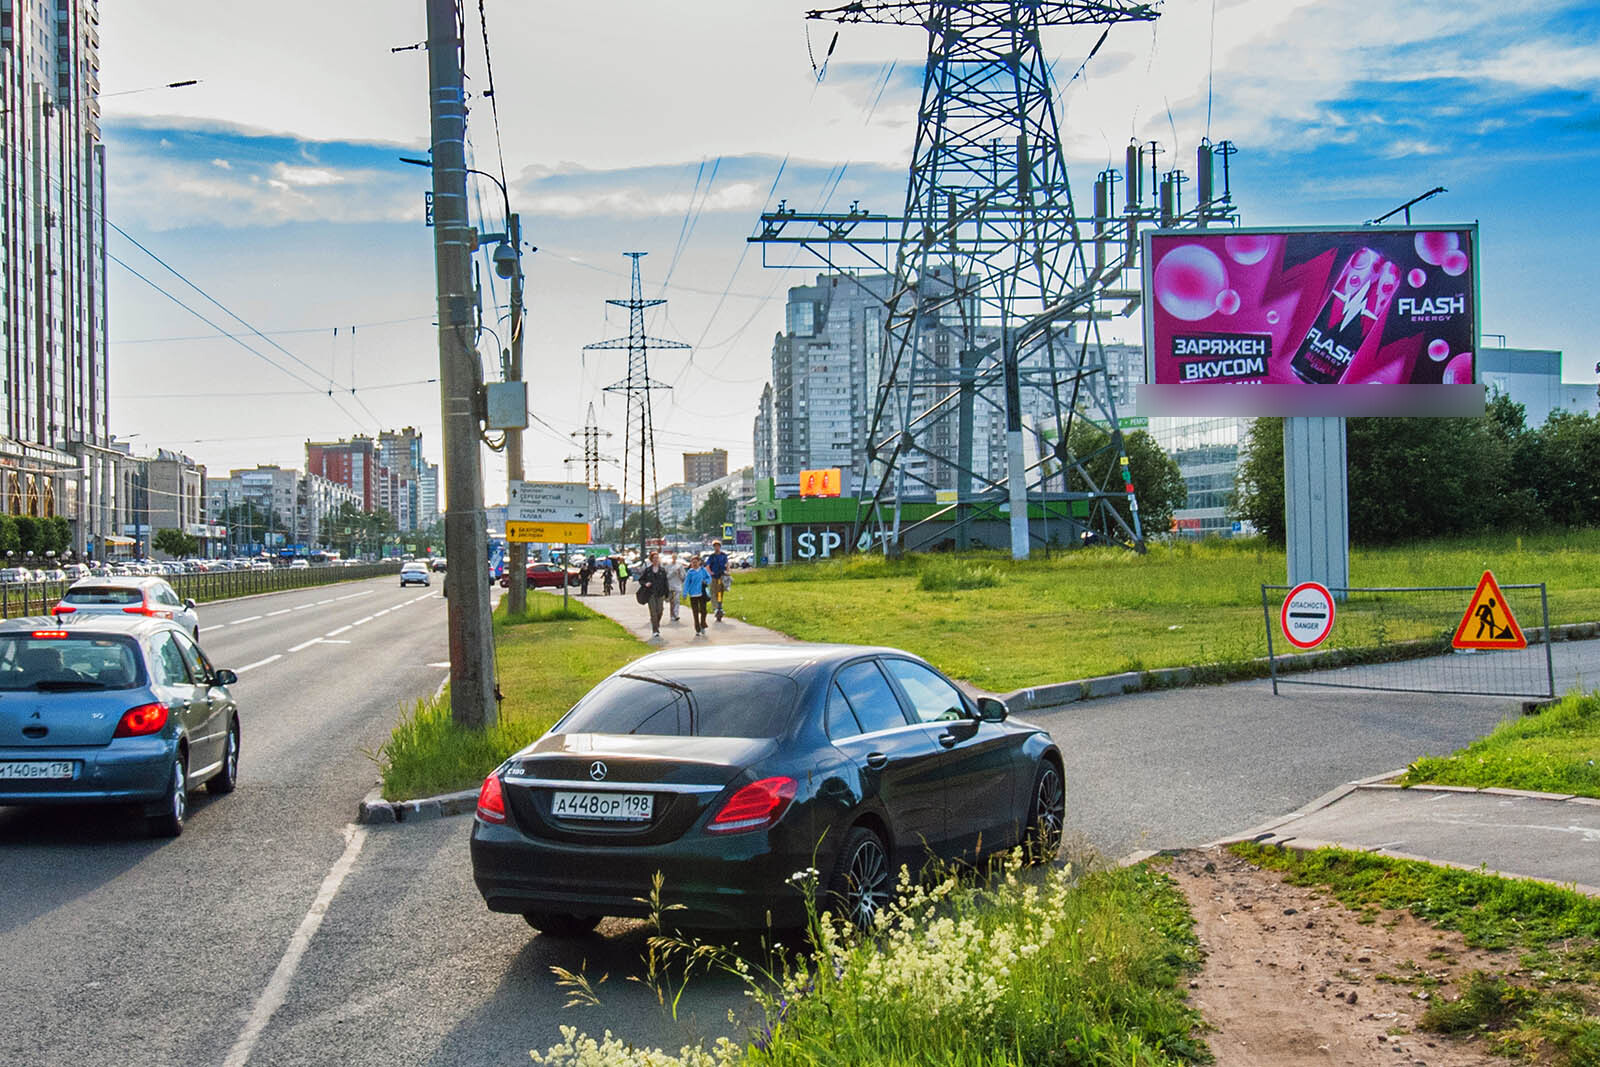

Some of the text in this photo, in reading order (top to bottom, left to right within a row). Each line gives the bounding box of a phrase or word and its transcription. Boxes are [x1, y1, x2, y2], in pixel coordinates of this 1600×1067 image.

[1398, 296, 1465, 315] FLASH
[1175, 339, 1265, 355] ЗАРЯЖЕН
[1306, 327, 1355, 366] FLASH
[1185, 357, 1264, 379] ВКУСОМ
[1290, 601, 1327, 609] ОПАСНОСТЬ
[557, 794, 648, 814] А448ОР 198
